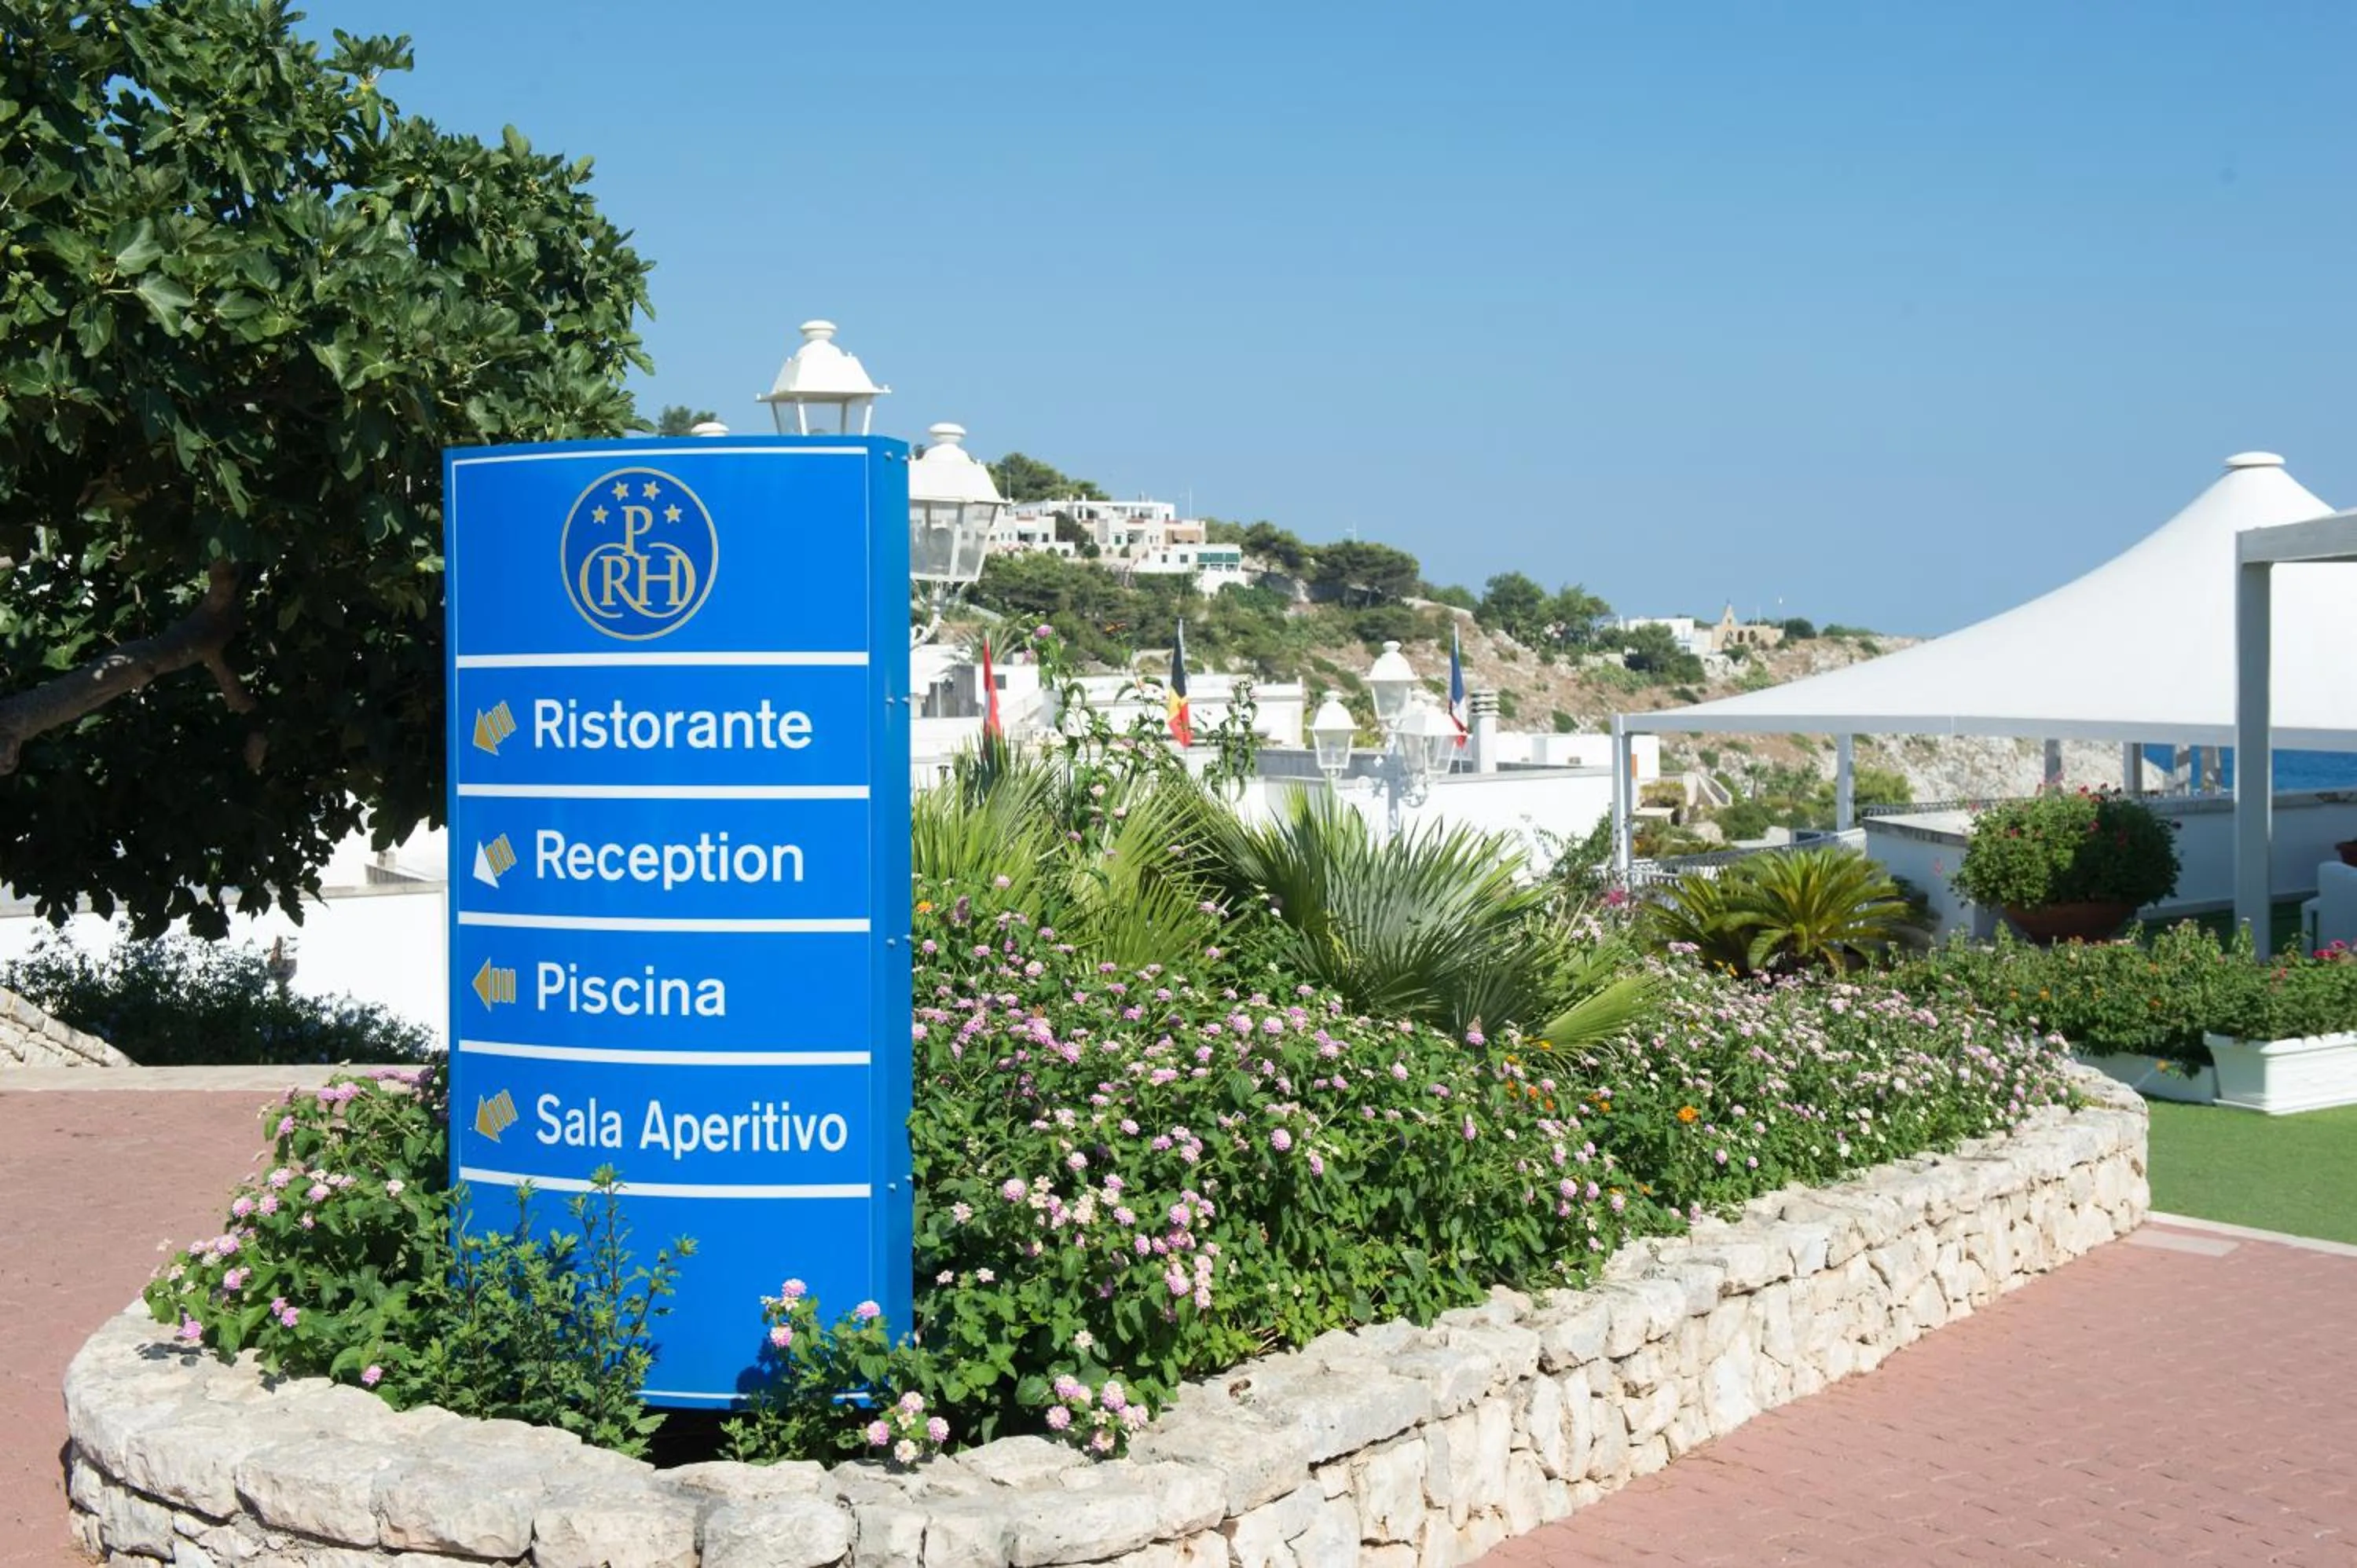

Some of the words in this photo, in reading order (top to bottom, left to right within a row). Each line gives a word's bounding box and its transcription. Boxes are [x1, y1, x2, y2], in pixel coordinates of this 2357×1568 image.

[534, 699, 812, 749] Ristorante
[536, 830, 804, 891] Reception
[537, 962, 726, 1017] Piscina
[536, 1094, 622, 1149] Sala
[640, 1101, 848, 1160] Aperitivo
